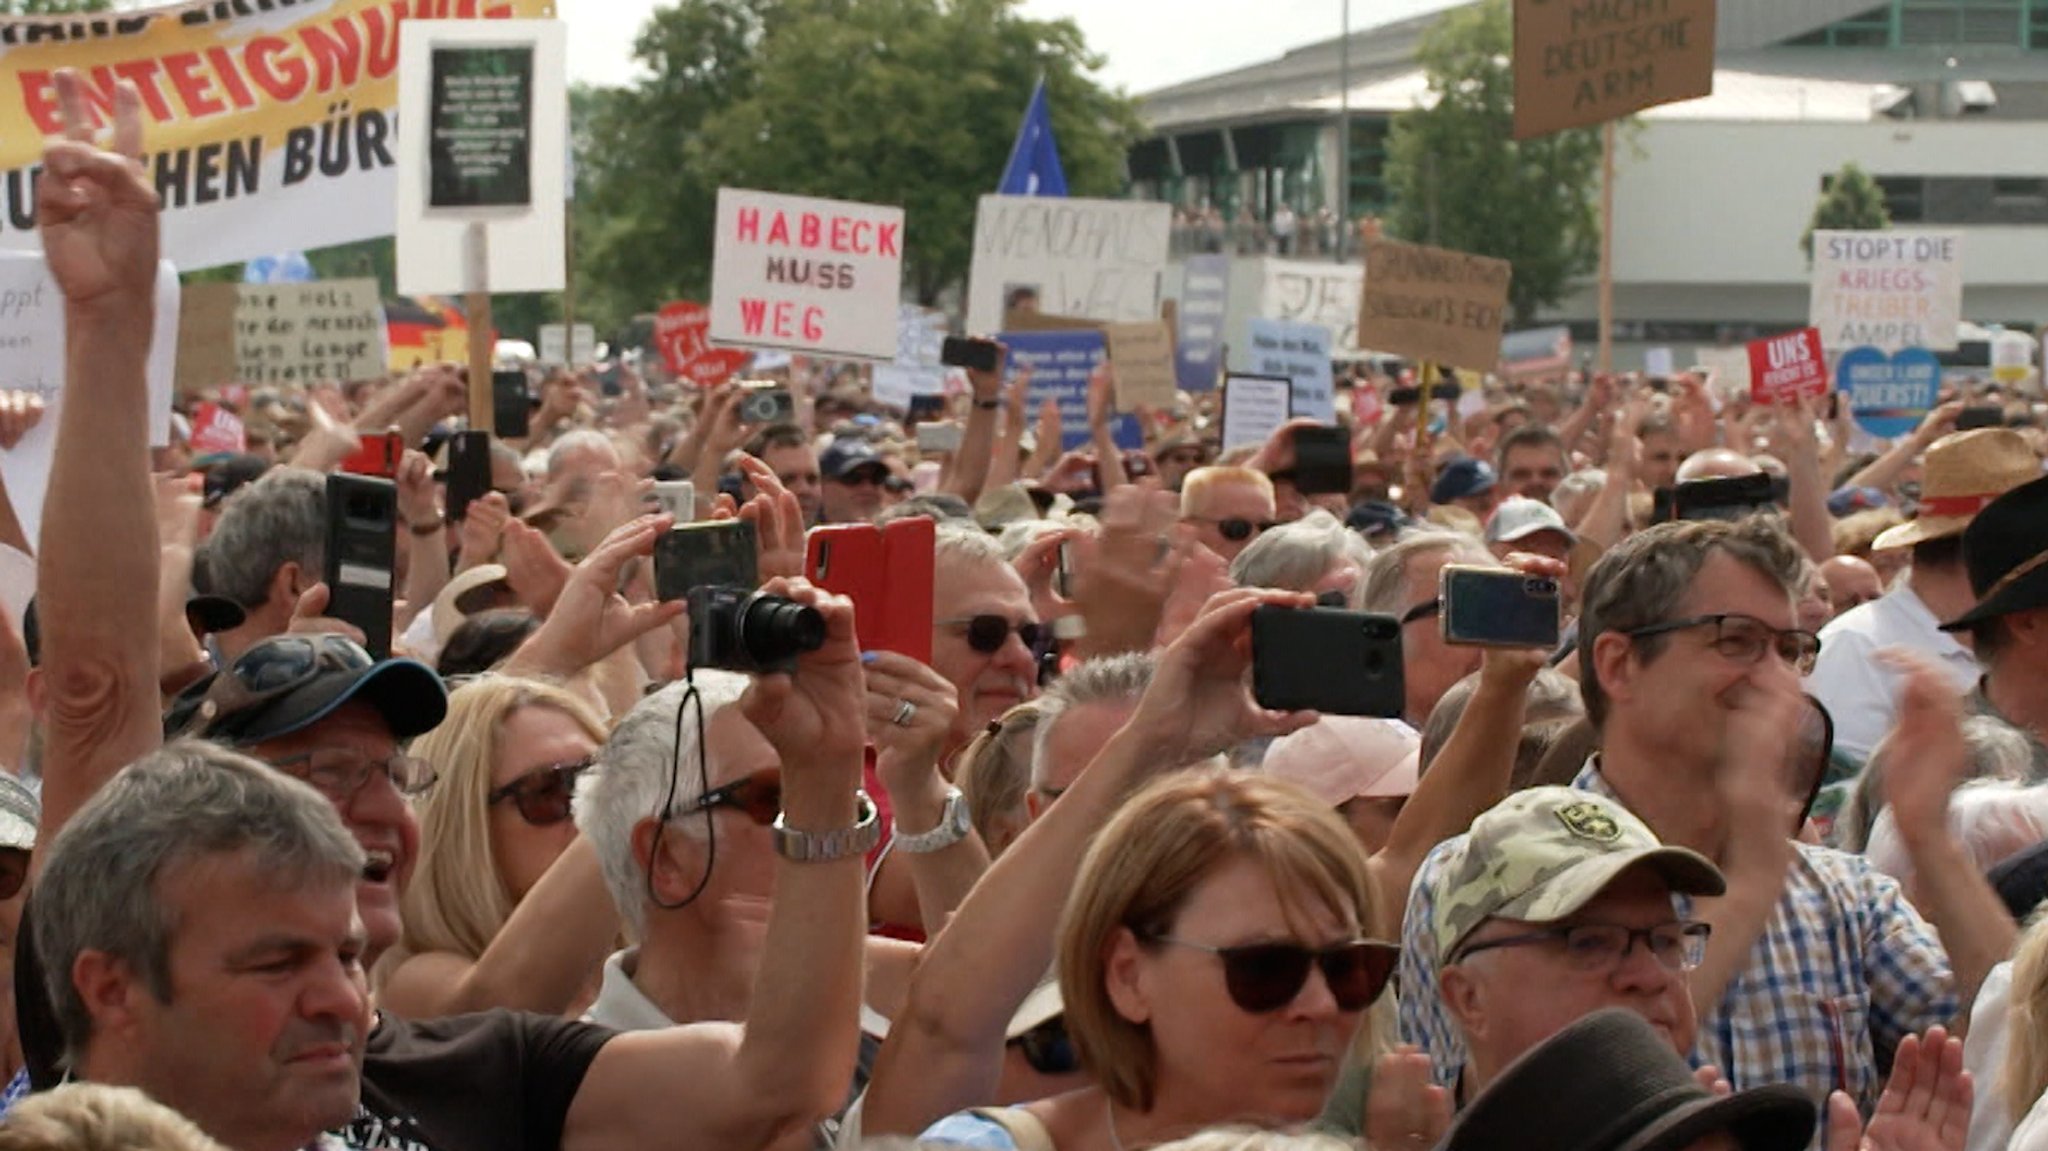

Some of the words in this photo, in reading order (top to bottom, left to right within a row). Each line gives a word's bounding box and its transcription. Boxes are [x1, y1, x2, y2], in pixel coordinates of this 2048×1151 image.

[1544, 17, 1690, 79] DEUTSCHE
[1573, 63, 1655, 110] ARM
[282, 101, 398, 188] BÜR
[737, 207, 899, 263] HABECK
[1829, 237, 1906, 261] STOPT
[1914, 237, 1954, 263] DIE
[738, 299, 825, 342] WEG
[1768, 332, 1811, 369] UNS
